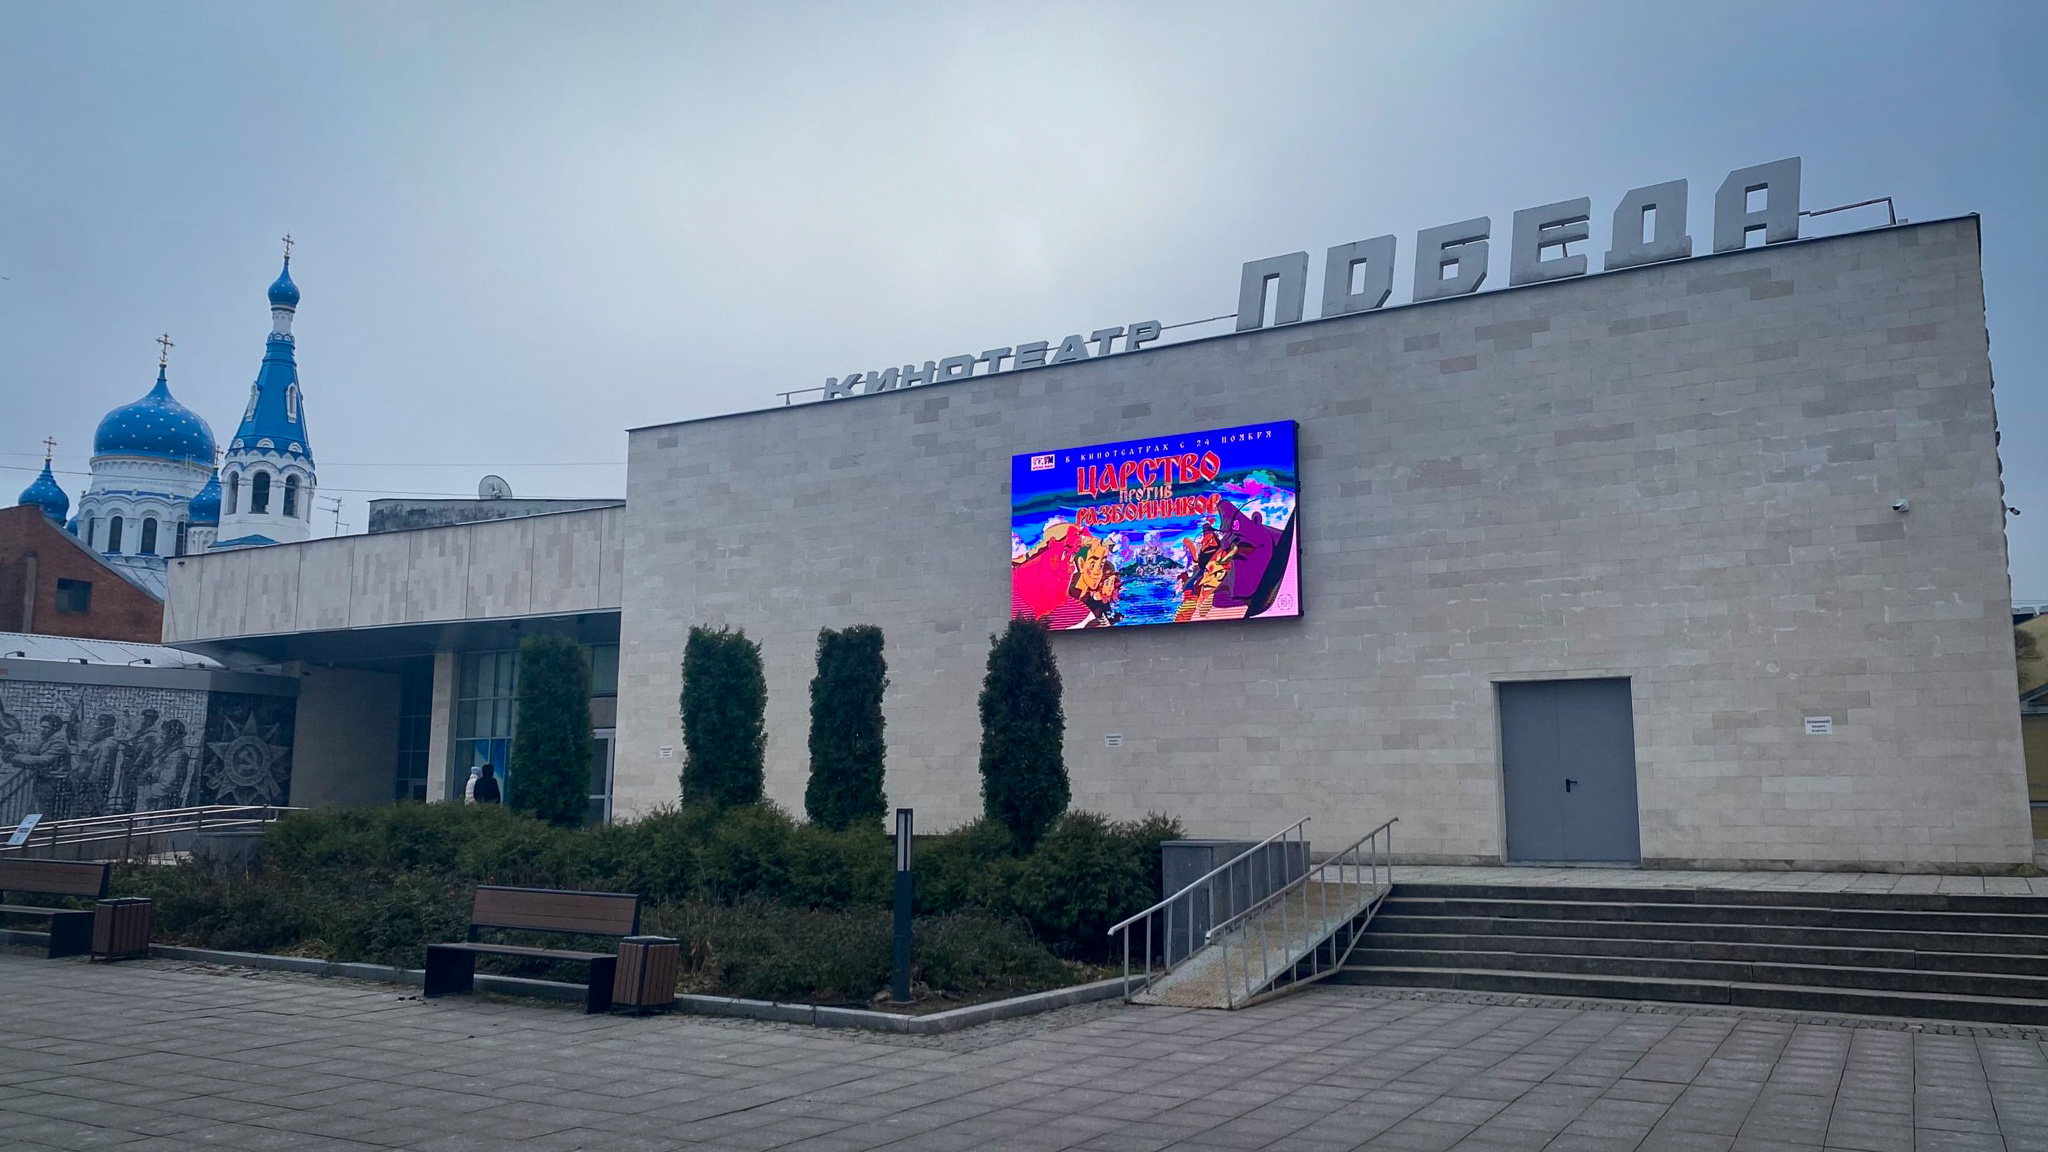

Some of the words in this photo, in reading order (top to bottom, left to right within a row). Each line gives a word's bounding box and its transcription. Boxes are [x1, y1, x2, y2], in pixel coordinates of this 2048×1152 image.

[1236, 156, 1801, 332] ПОБЕДА
[823, 320, 1162, 400] КИНОТЕАТР
[1080, 443, 1169, 462] КИНОТЕАТРАХ
[1196, 438, 1210, 447] 24
[1221, 430, 1272, 444] НОЯБРЯ
[1076, 450, 1221, 500] ЦАРСТВО
[1119, 485, 1173, 503] ПРОТИВ
[1076, 493, 1222, 527] РАЗБОЙНИКОВ
